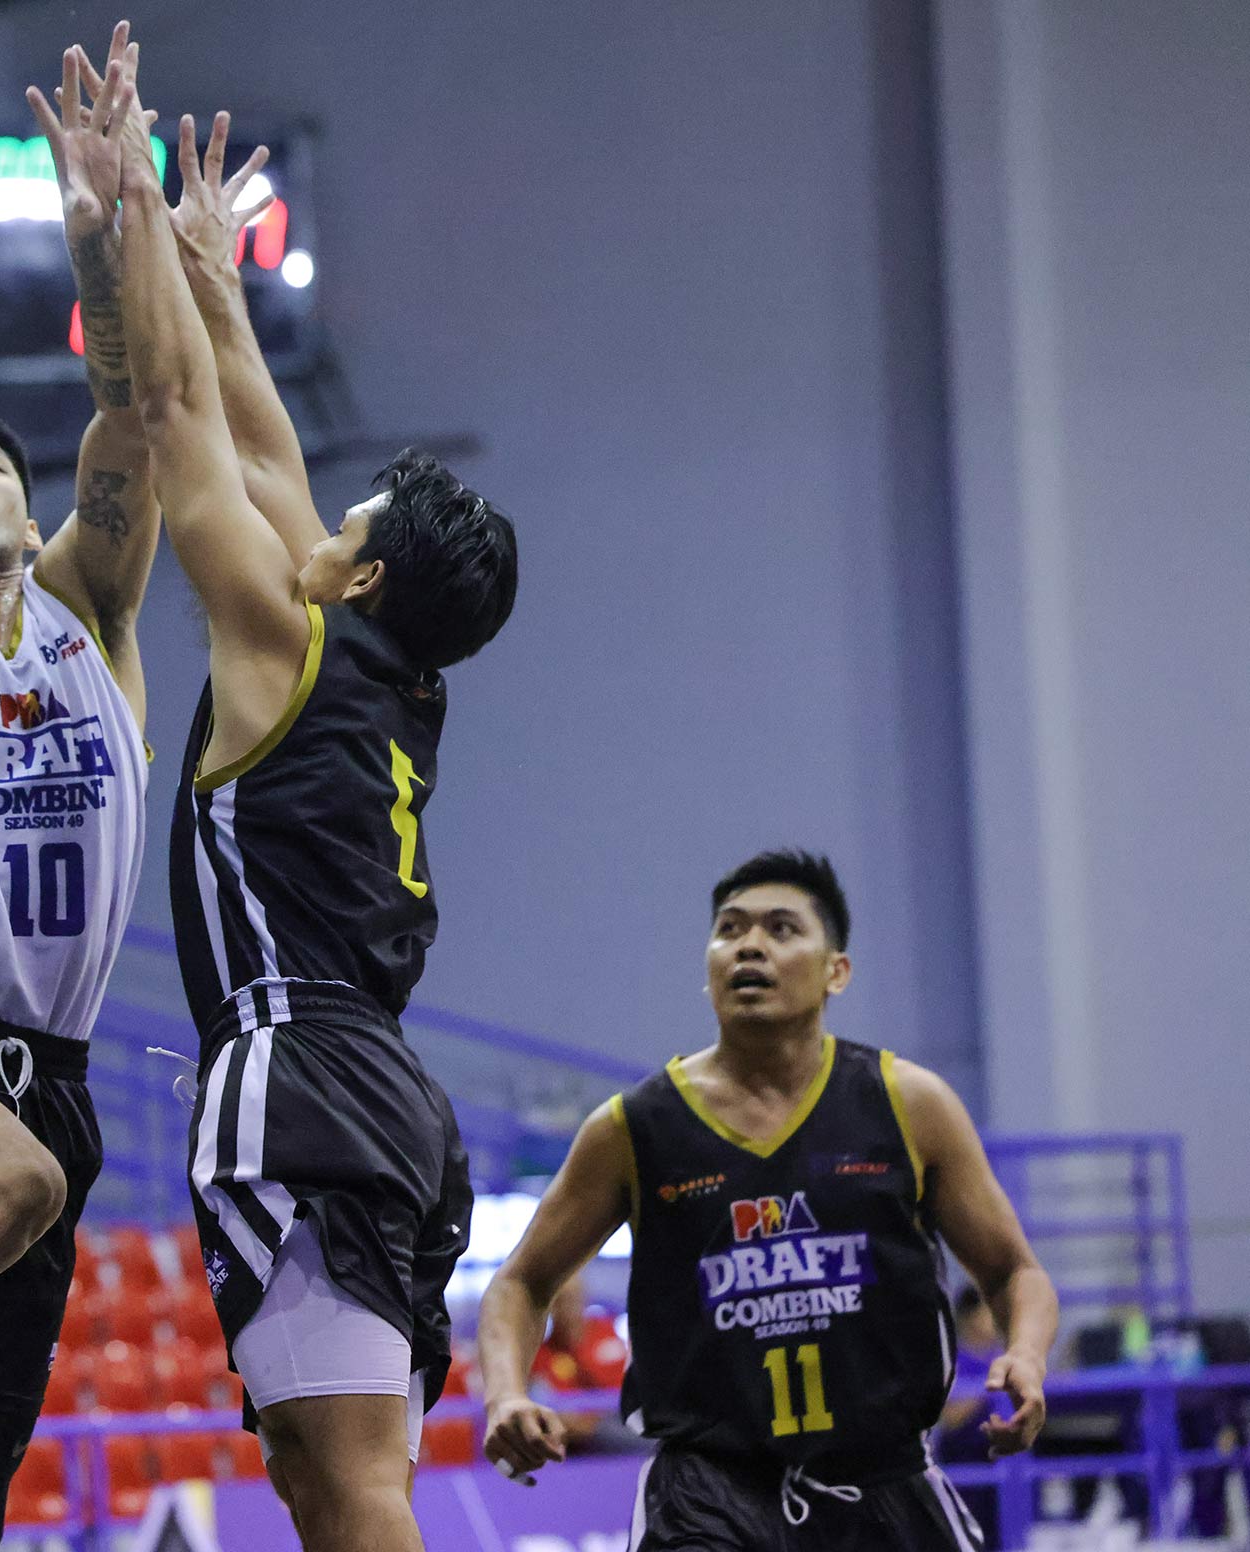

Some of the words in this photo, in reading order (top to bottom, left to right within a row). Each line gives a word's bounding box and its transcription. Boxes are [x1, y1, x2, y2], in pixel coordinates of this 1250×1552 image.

[4, 816, 65, 831] SEASON
[67, 814, 85, 829] 49
[2, 842, 86, 937] 10
[730, 1191, 820, 1243] PBA
[700, 1233, 868, 1299] DRAFT
[714, 1284, 863, 1331] COMBINE
[762, 1343, 835, 1437] 11
